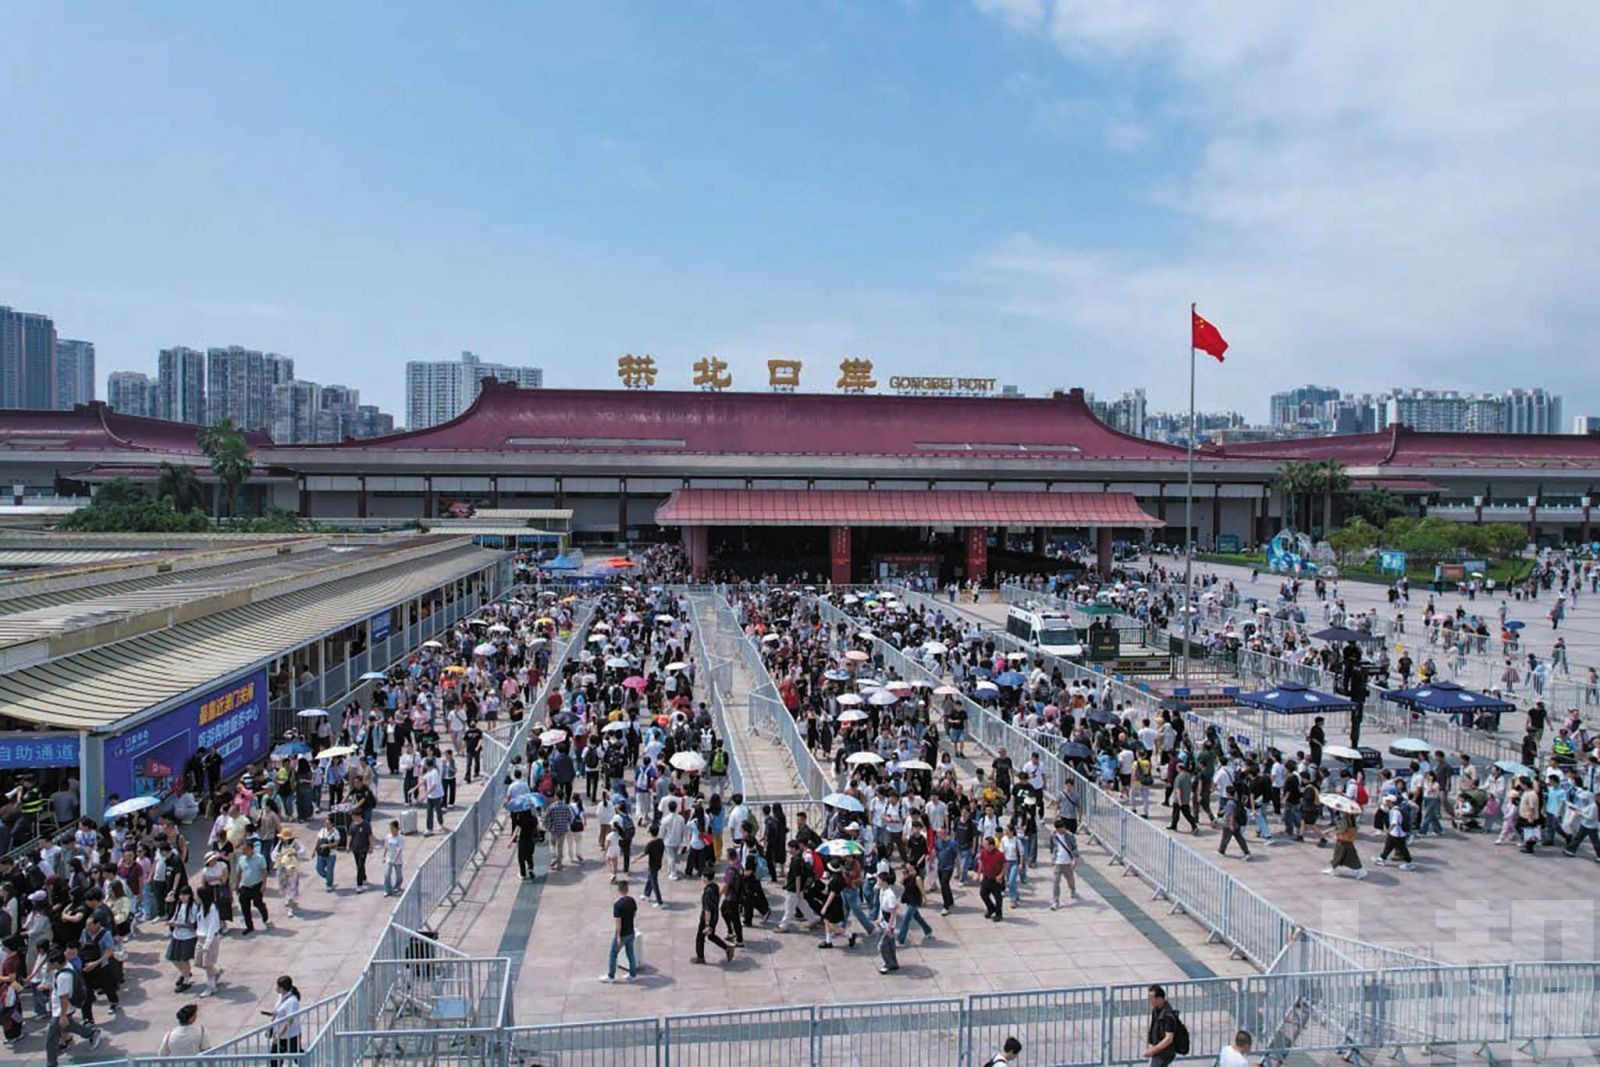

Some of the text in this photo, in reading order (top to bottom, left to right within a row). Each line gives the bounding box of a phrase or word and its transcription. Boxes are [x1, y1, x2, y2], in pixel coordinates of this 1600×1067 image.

[618, 354, 877, 388] 拱北口岸
[889, 376, 997, 390] GONGBEI PORT
[0, 744, 74, 761] 自助通道
